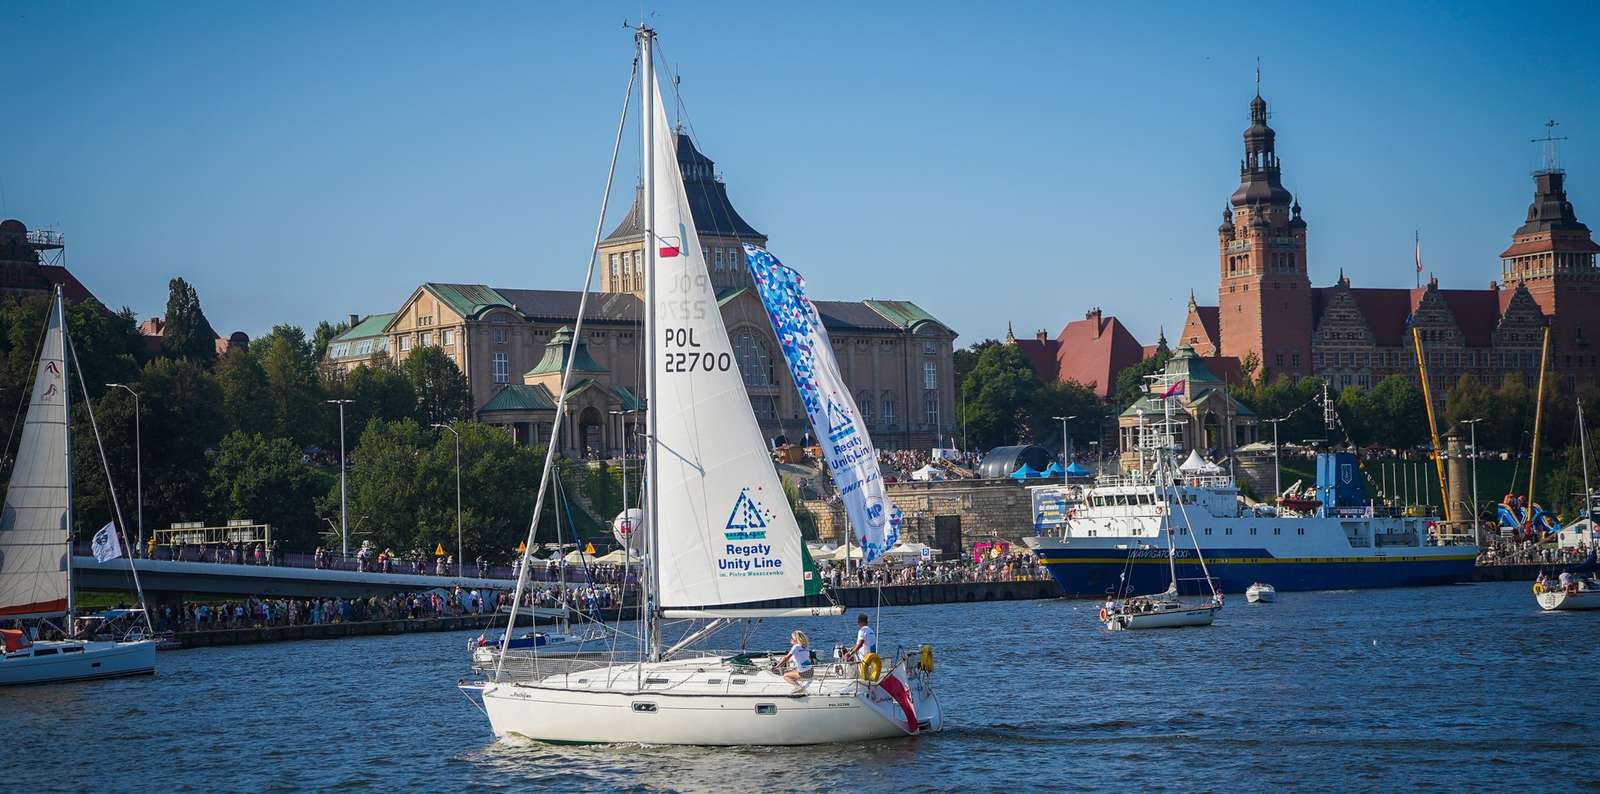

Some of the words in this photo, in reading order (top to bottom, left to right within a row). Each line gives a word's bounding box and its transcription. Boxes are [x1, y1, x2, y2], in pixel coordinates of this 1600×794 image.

[665, 327, 701, 348] POL
[665, 352, 731, 373] 22700
[854, 446, 870, 460] Lin
[726, 543, 771, 556] Regaty
[1130, 550, 1174, 559] NAWIGATO
[718, 558, 751, 571] Unity
[754, 557, 782, 568] Line
